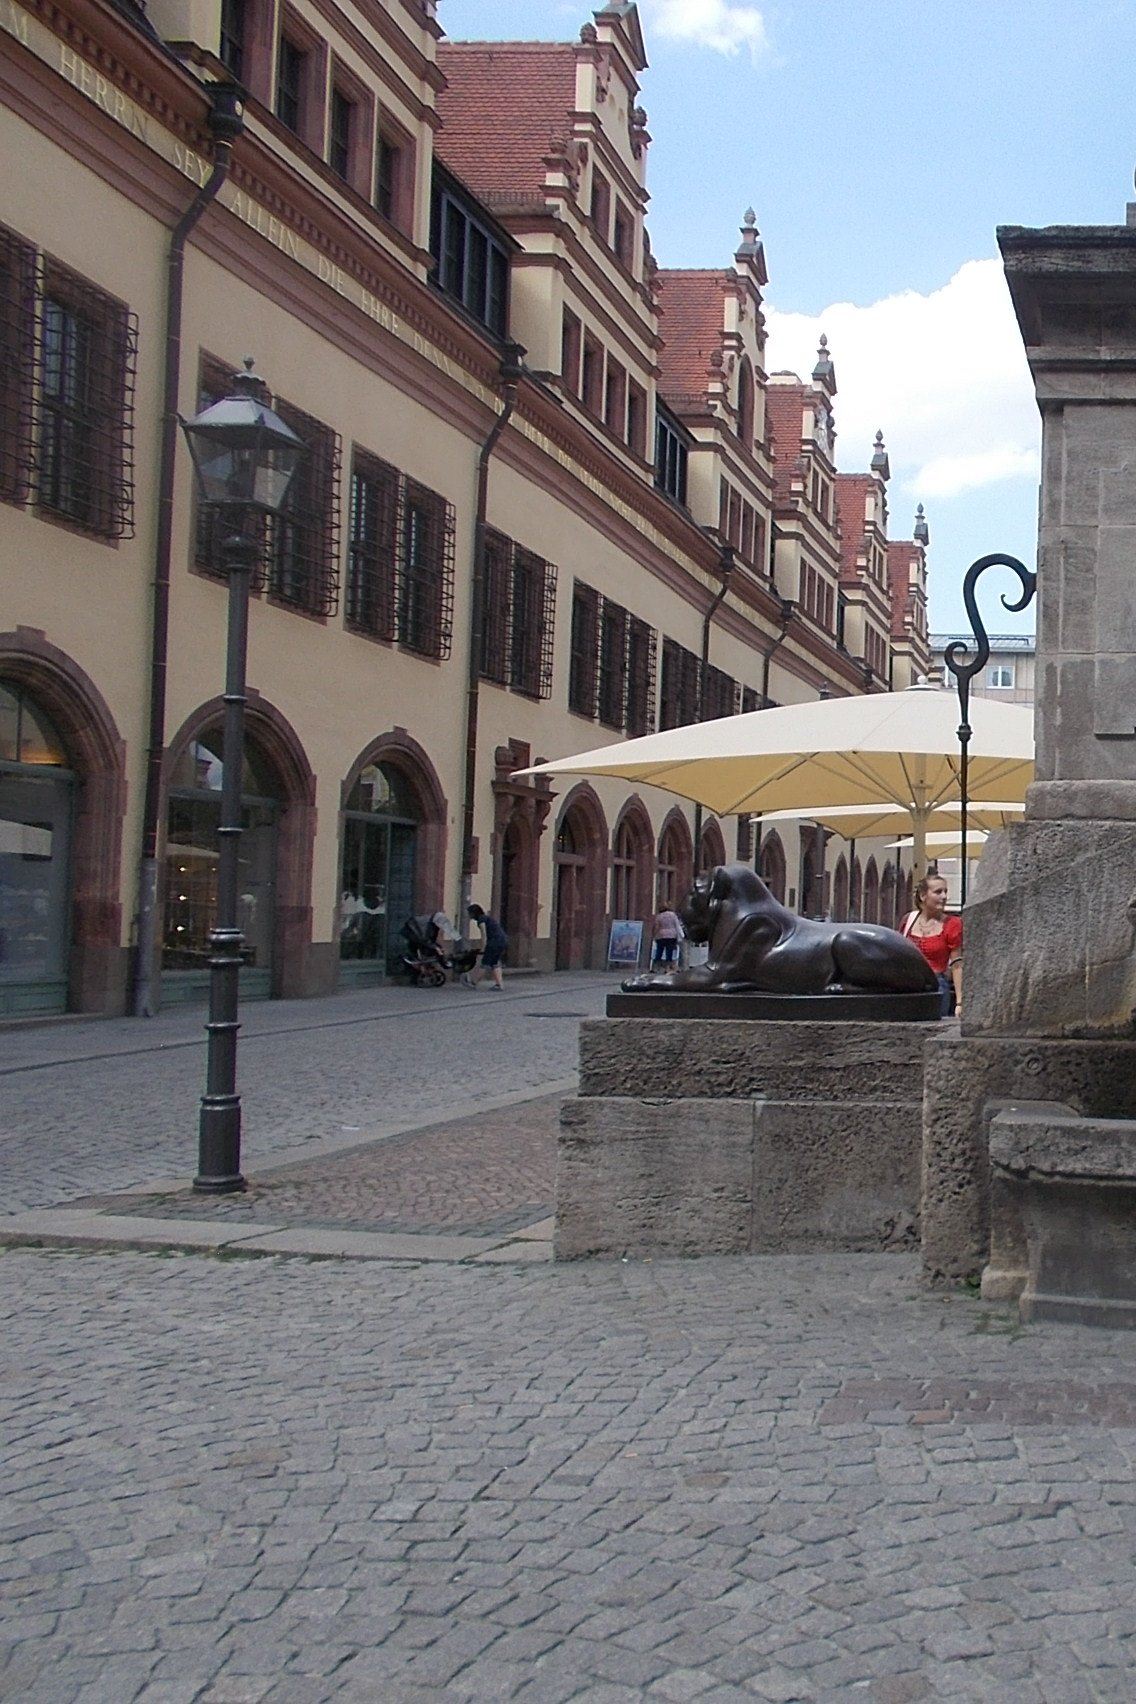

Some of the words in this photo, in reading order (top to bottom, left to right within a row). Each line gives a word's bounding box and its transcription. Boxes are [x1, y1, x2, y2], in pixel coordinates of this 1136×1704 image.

[59, 43, 148, 145] HERRN
[172, 143, 212, 188] SEY
[231, 190, 300, 259] ALLEIN
[318, 253, 344, 292] DIE
[362, 287, 399, 335] EHRE
